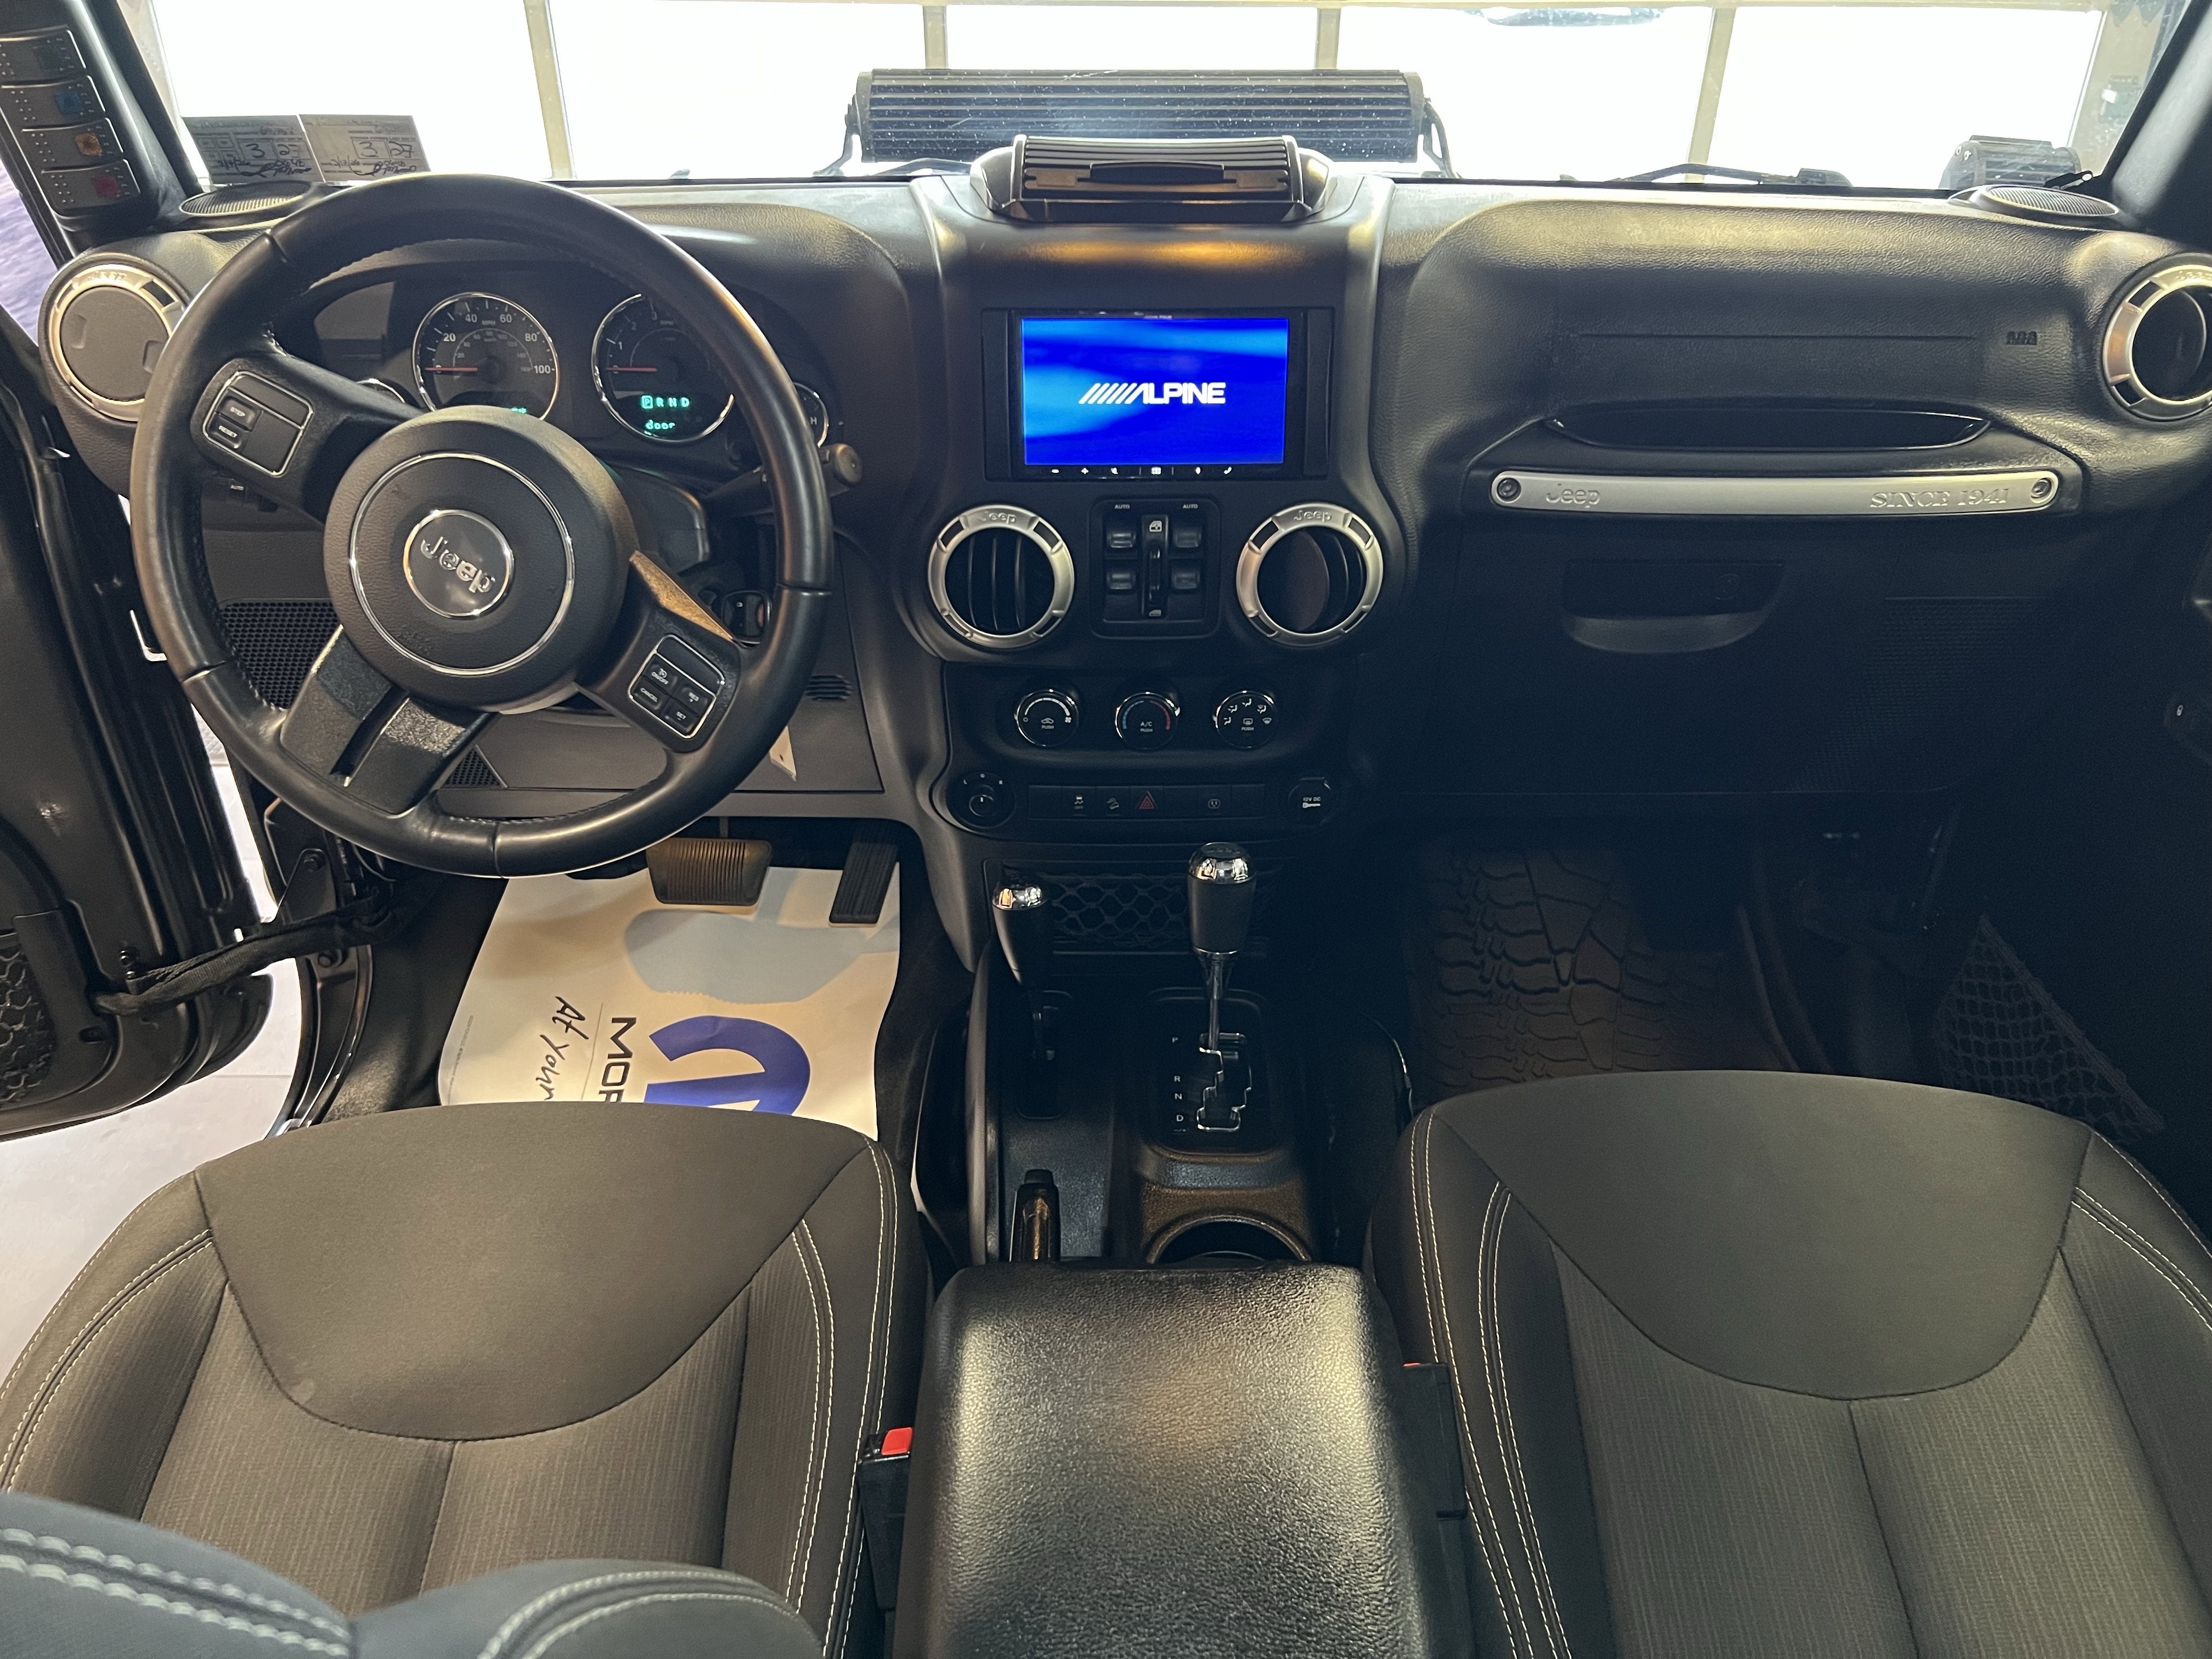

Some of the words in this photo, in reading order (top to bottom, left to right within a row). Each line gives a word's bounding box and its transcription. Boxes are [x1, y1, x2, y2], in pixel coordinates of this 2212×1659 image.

[359, 142, 379, 157] 3
[465, 314, 477, 323] 40
[500, 314, 512, 323] 60
[443, 333, 456, 342] 20
[524, 333, 537, 342] 80
[618, 341, 623, 350] 1
[534, 365, 551, 374] 100
[1125, 382, 1226, 404] ALPINE
[656, 397, 664, 407] R
[668, 397, 677, 408] N
[681, 397, 690, 408] D
[645, 419, 675, 430] door
[810, 416, 817, 425] H
[1545, 483, 1601, 509] Jeep
[1870, 491, 1950, 507] SINCE
[1957, 488, 2010, 506] 1941
[977, 511, 1017, 524] Jeep
[1293, 510, 1333, 523] Jeep
[420, 536, 496, 593] Jeep
[552, 996, 589, 1040] At
[1176, 1113, 1184, 1121] D
